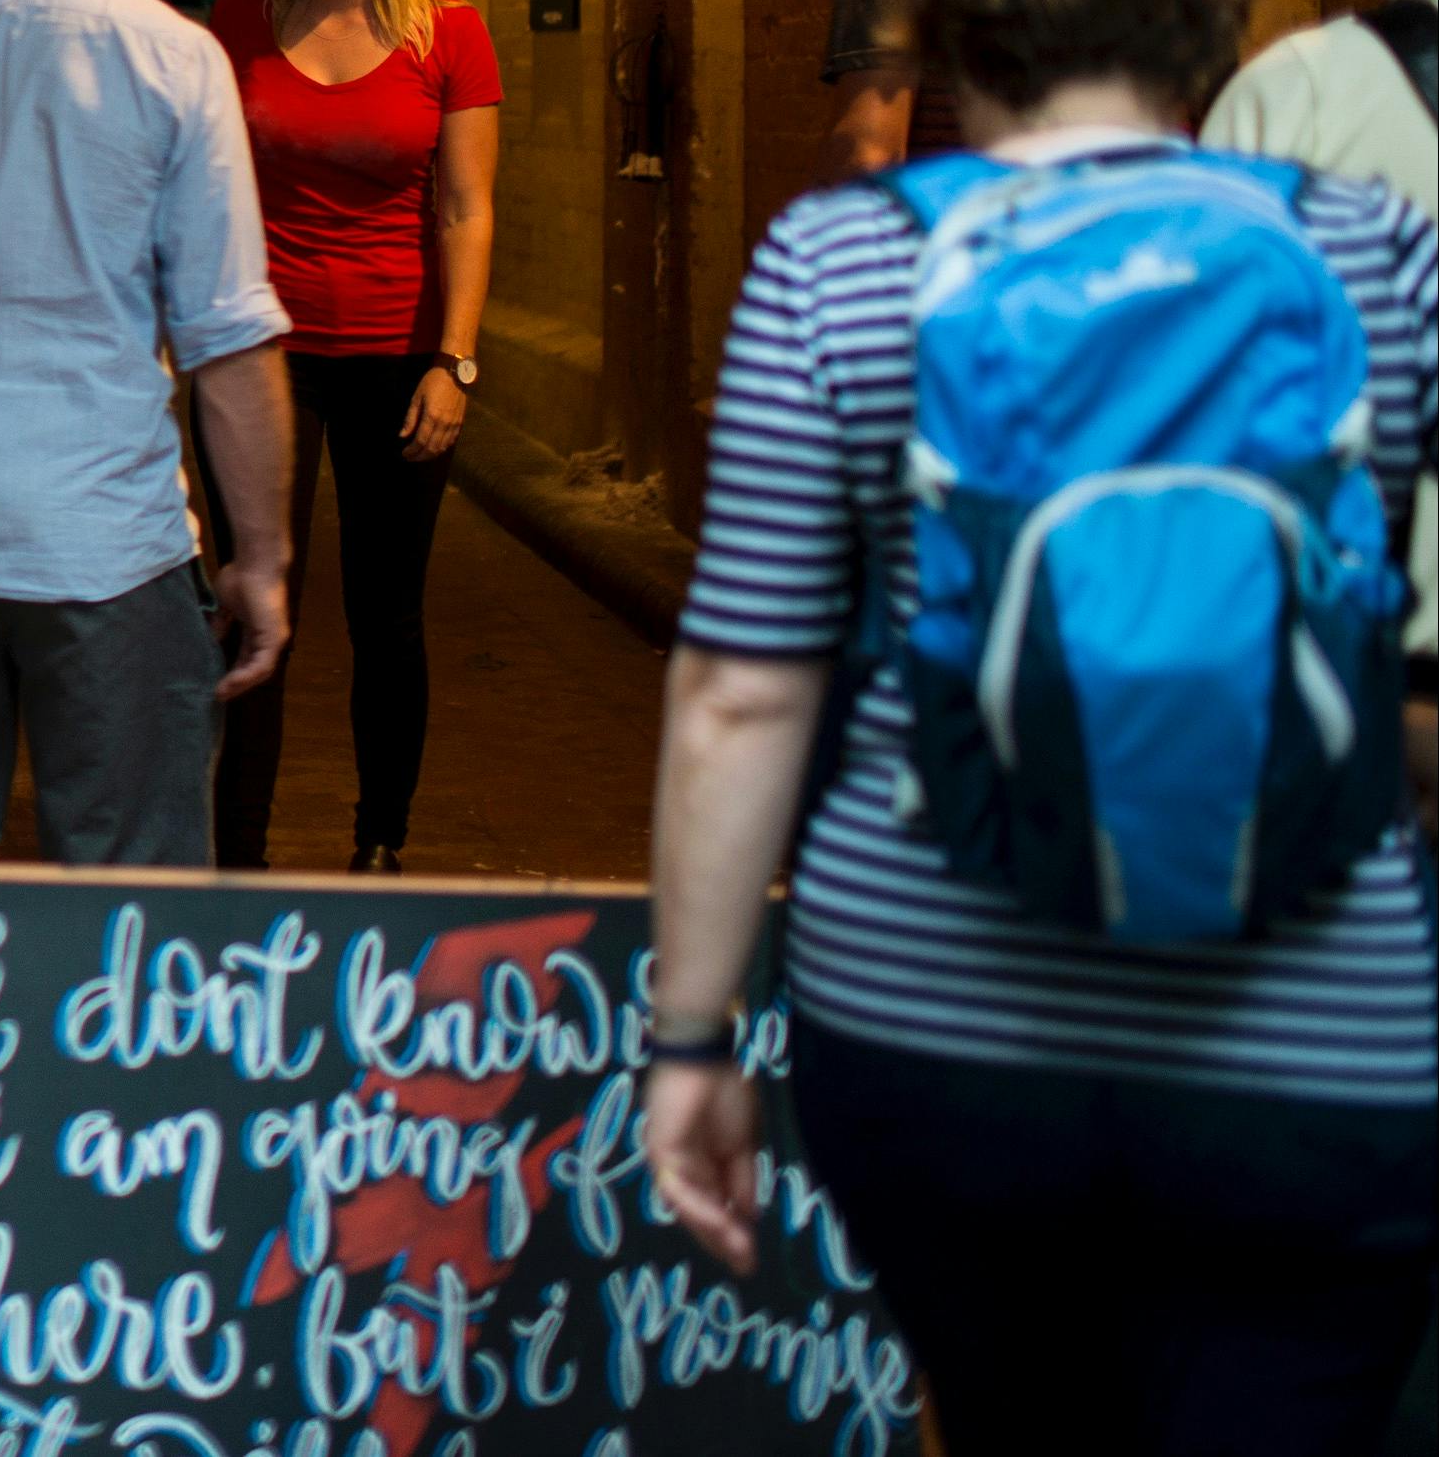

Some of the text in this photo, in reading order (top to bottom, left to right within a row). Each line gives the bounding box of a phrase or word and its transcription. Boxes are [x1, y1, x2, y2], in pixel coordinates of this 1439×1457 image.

[54, 901, 325, 1080] dont
[335, 926, 613, 1082] know
[56, 1108, 224, 1253] am
[241, 1088, 537, 1275] going
[295, 1262, 509, 1421] but
[509, 1280, 579, 1408] i
[600, 1260, 925, 1457] promise
